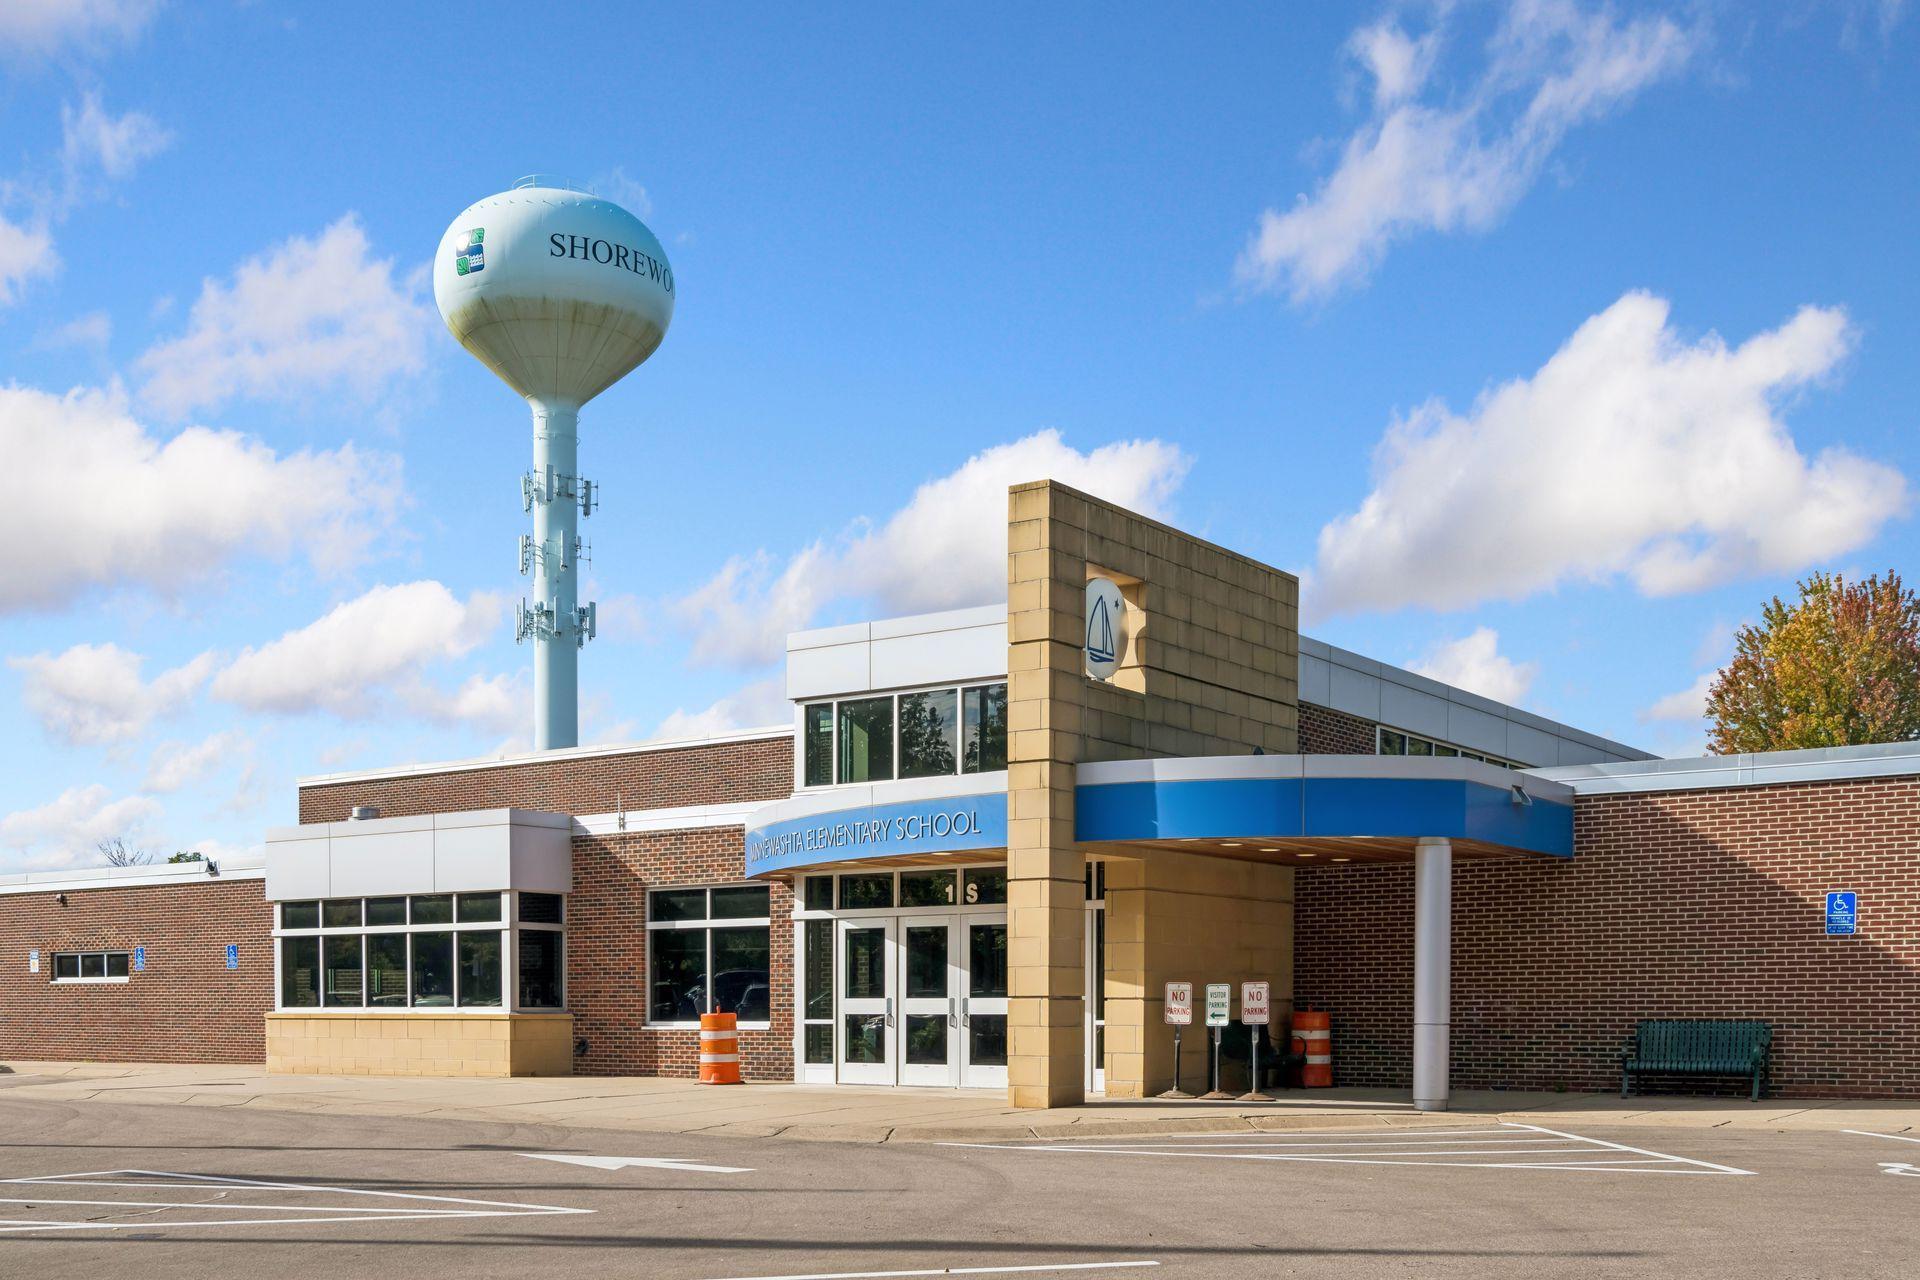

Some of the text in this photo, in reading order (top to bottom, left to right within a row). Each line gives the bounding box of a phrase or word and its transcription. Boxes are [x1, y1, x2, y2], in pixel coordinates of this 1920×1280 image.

[807, 818, 892, 851] ELEMENTARY
[895, 810, 982, 841] SCHOOL
[945, 883, 979, 903] 1 S
[1172, 991, 1186, 1001] NO
[1248, 991, 1263, 1001] NO
[1208, 1001, 1228, 1009] PARKING
[1167, 1007, 1191, 1015] PARKING
[1244, 1007, 1267, 1016] PARKING
